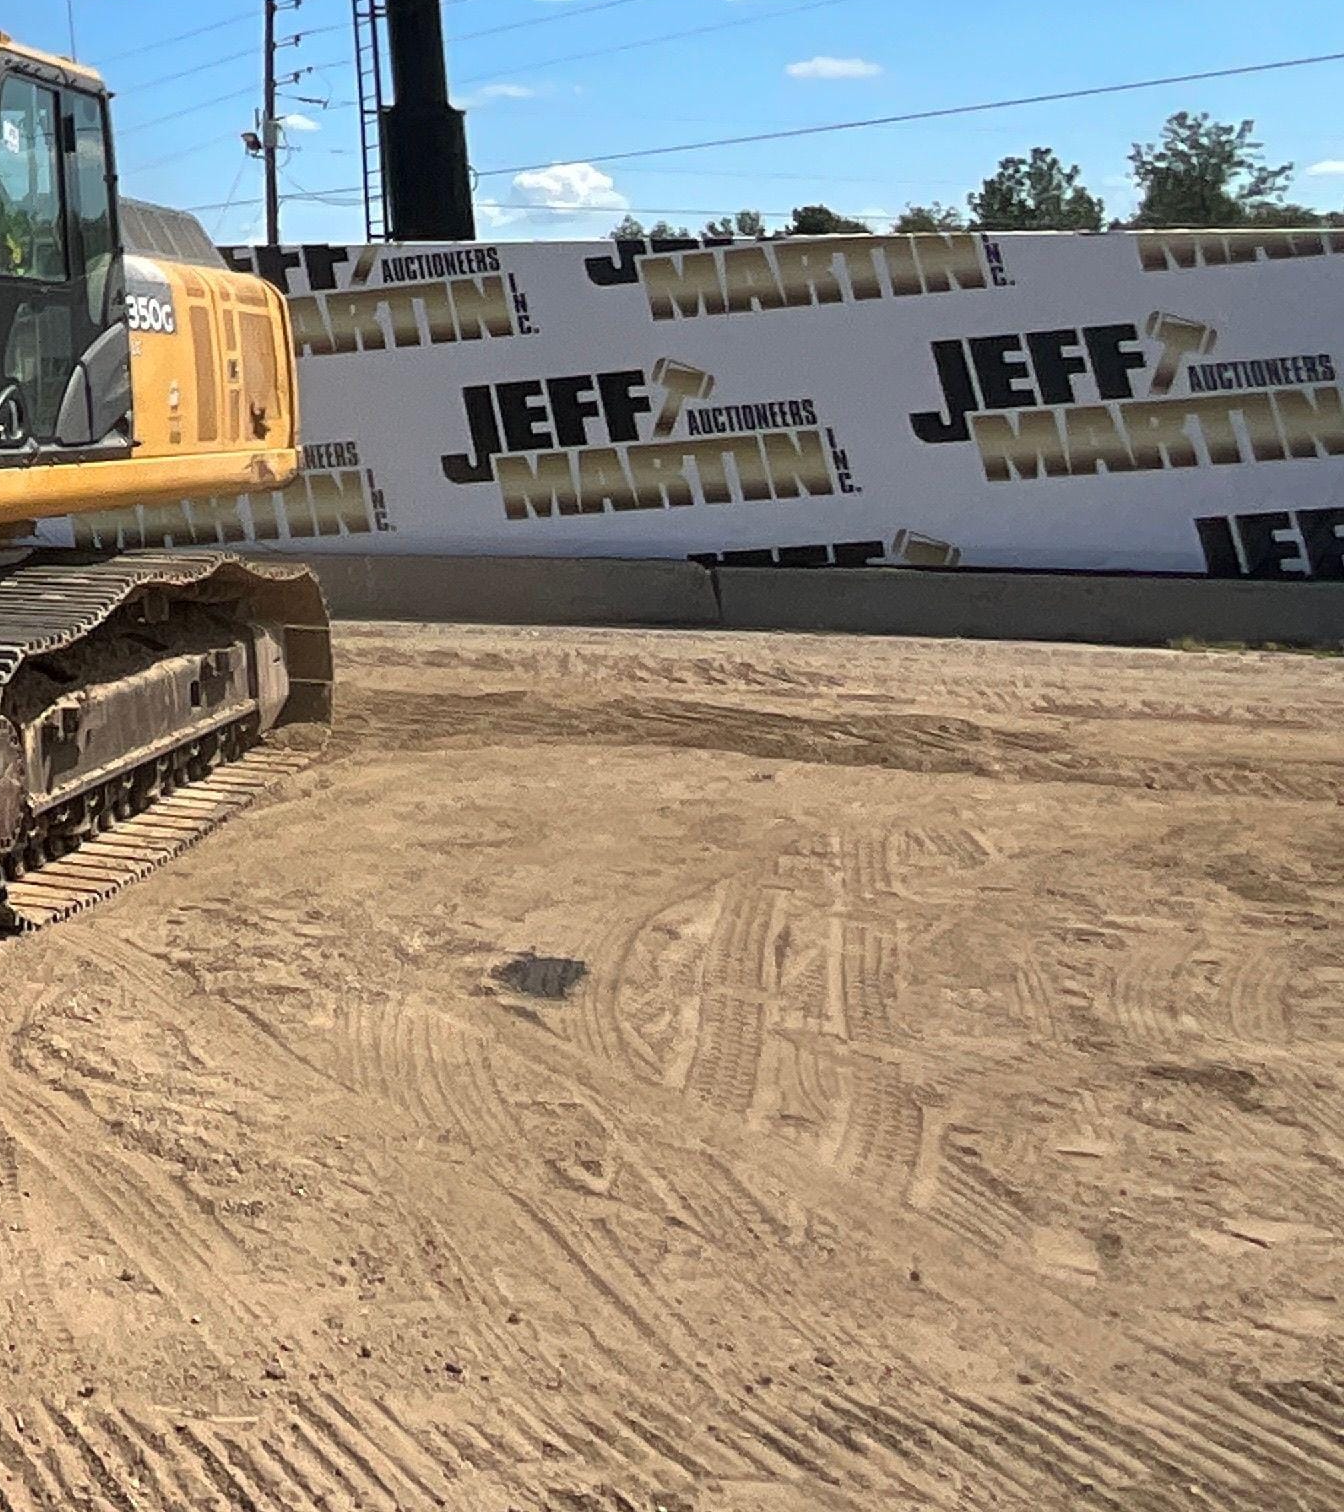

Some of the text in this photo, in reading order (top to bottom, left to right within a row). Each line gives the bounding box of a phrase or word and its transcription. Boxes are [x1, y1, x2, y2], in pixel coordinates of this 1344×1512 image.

[382, 247, 500, 283] AUCTIONEERS
[639, 234, 987, 322] MARTIN
[125, 295, 173, 333] 350G
[289, 275, 514, 357] ARTIN
[909, 324, 1146, 443] JEFF
[1187, 353, 1335, 393] AUCTIONEERS
[440, 369, 652, 485] JEFF
[687, 399, 818, 436] AUCTIONEERS
[972, 387, 1344, 482] MARTIN
[495, 430, 834, 520] MARTIN
